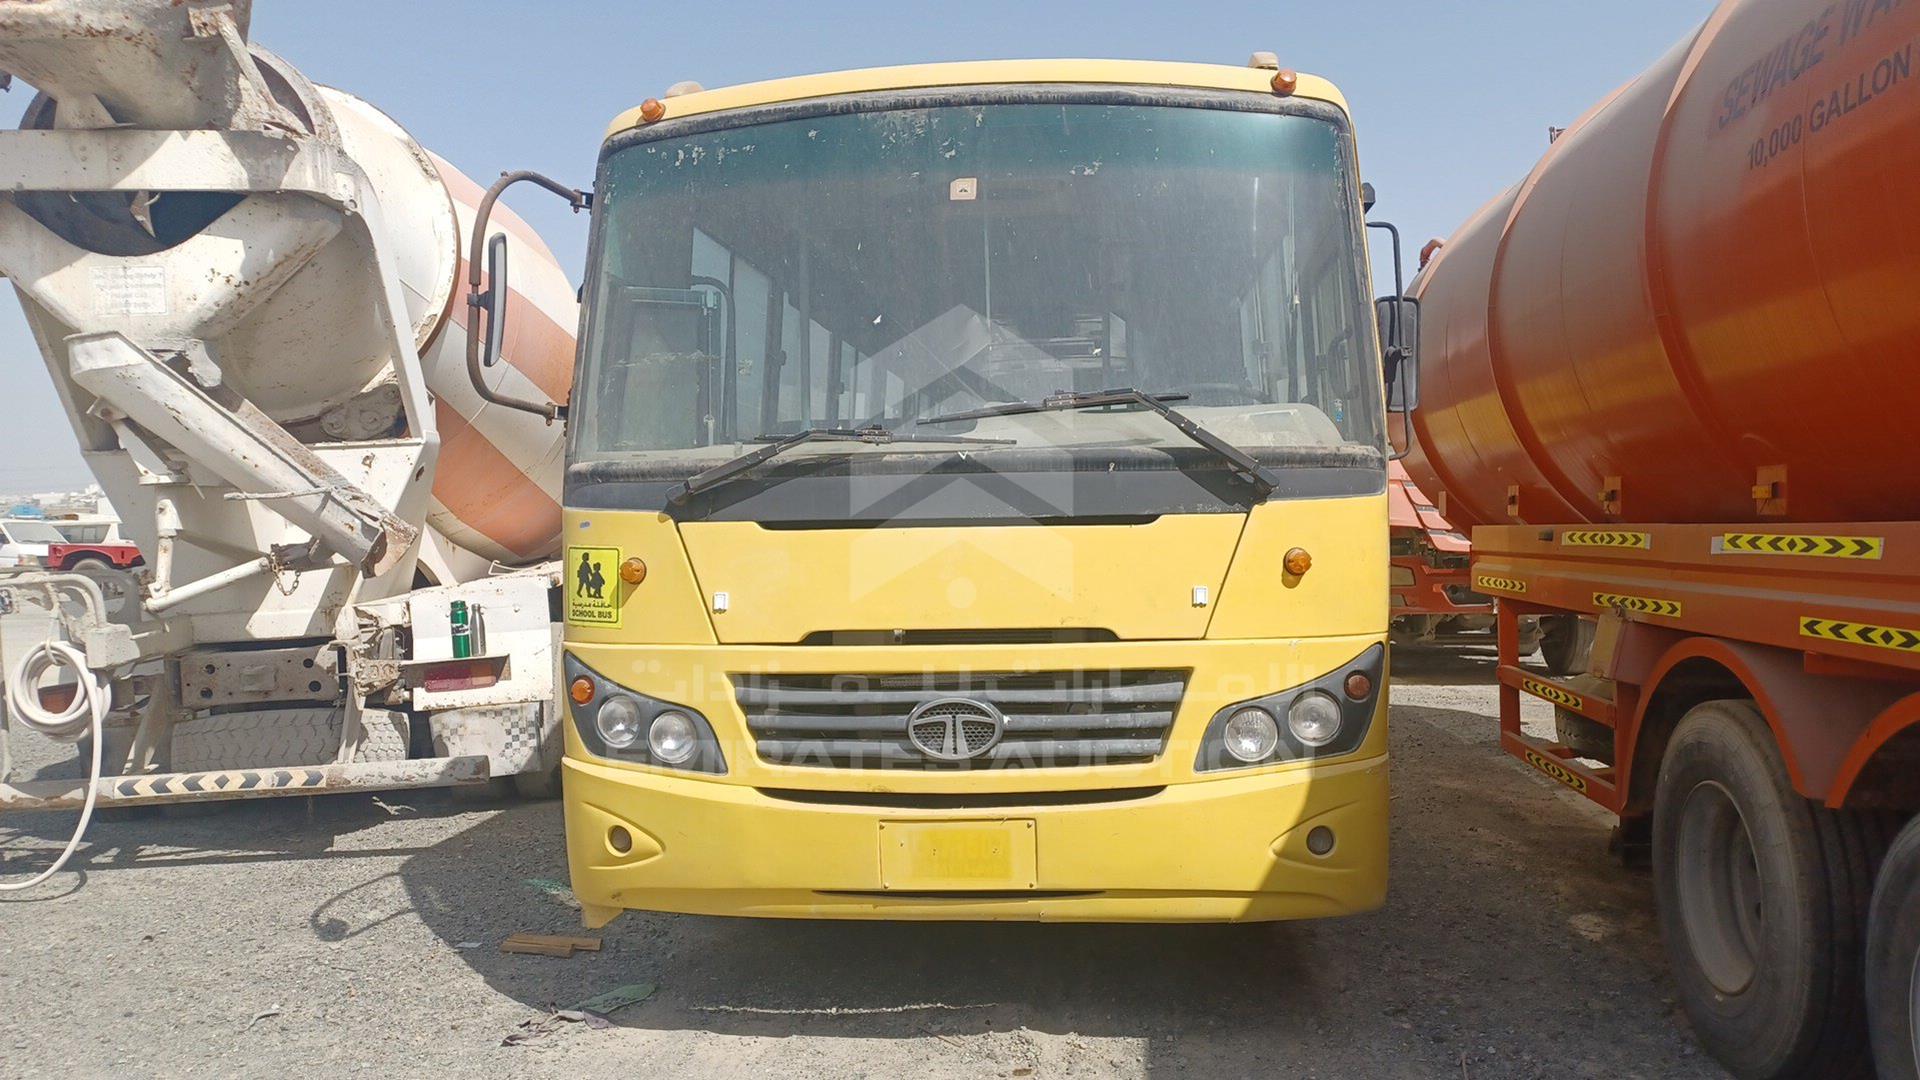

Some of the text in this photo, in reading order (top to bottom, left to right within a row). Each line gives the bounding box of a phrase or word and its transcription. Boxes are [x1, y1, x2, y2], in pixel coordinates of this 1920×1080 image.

[1718, 0, 1900, 130] SEWAGE WA
[1747, 114, 1803, 170] 10,000
[572, 609, 613, 619] SCHOOL BUS
